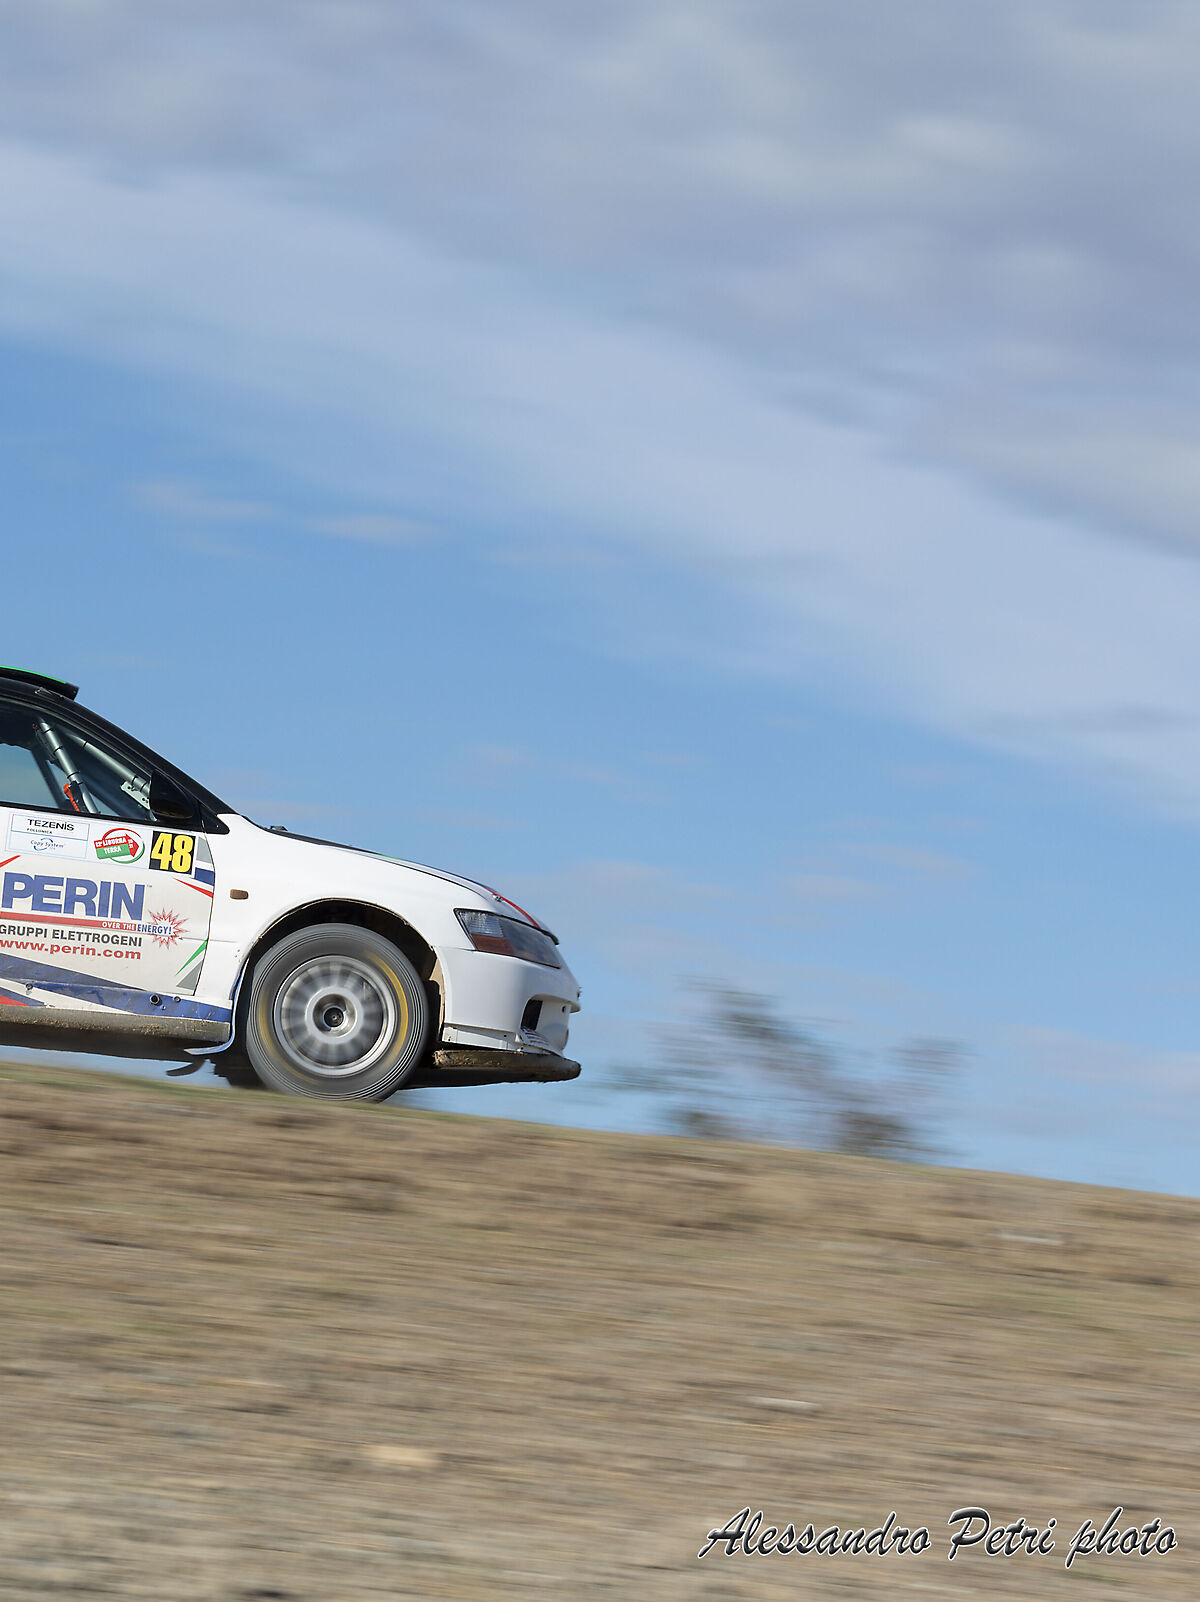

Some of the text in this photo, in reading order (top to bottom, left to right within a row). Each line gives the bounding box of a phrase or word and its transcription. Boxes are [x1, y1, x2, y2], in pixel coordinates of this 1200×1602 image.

[30, 838, 64, 850] Copy System
[104, 846, 122, 854] TERRA
[151, 832, 194, 873] 48
[1, 871, 146, 921] PERIN
[52, 928, 142, 947] ELETTROGENI
[102, 921, 172, 935] OVER THE ENERGY!
[0, 937, 141, 960] www.perin.com
